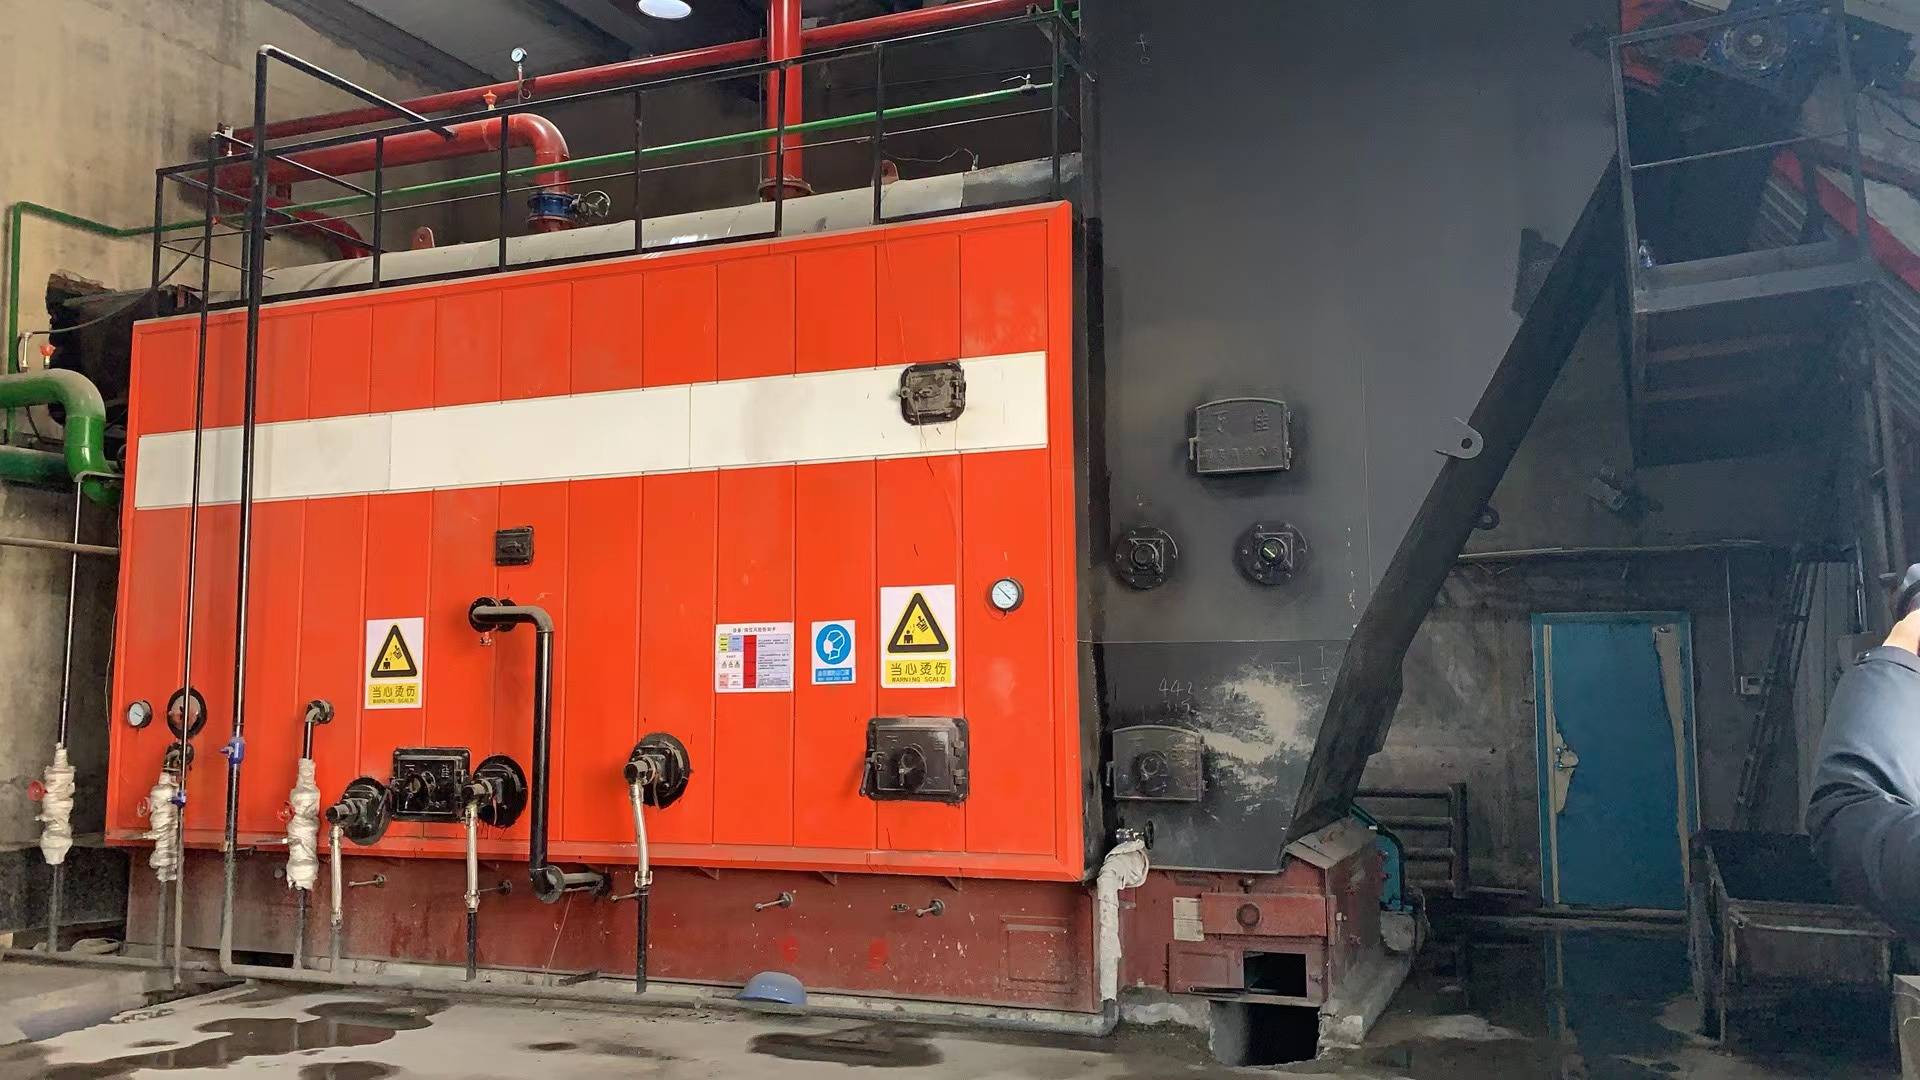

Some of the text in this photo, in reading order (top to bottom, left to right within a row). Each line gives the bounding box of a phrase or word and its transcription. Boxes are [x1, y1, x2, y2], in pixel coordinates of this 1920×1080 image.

[890, 662, 948, 676] 当心烫伤
[372, 685, 416, 698] 当心烫伤
